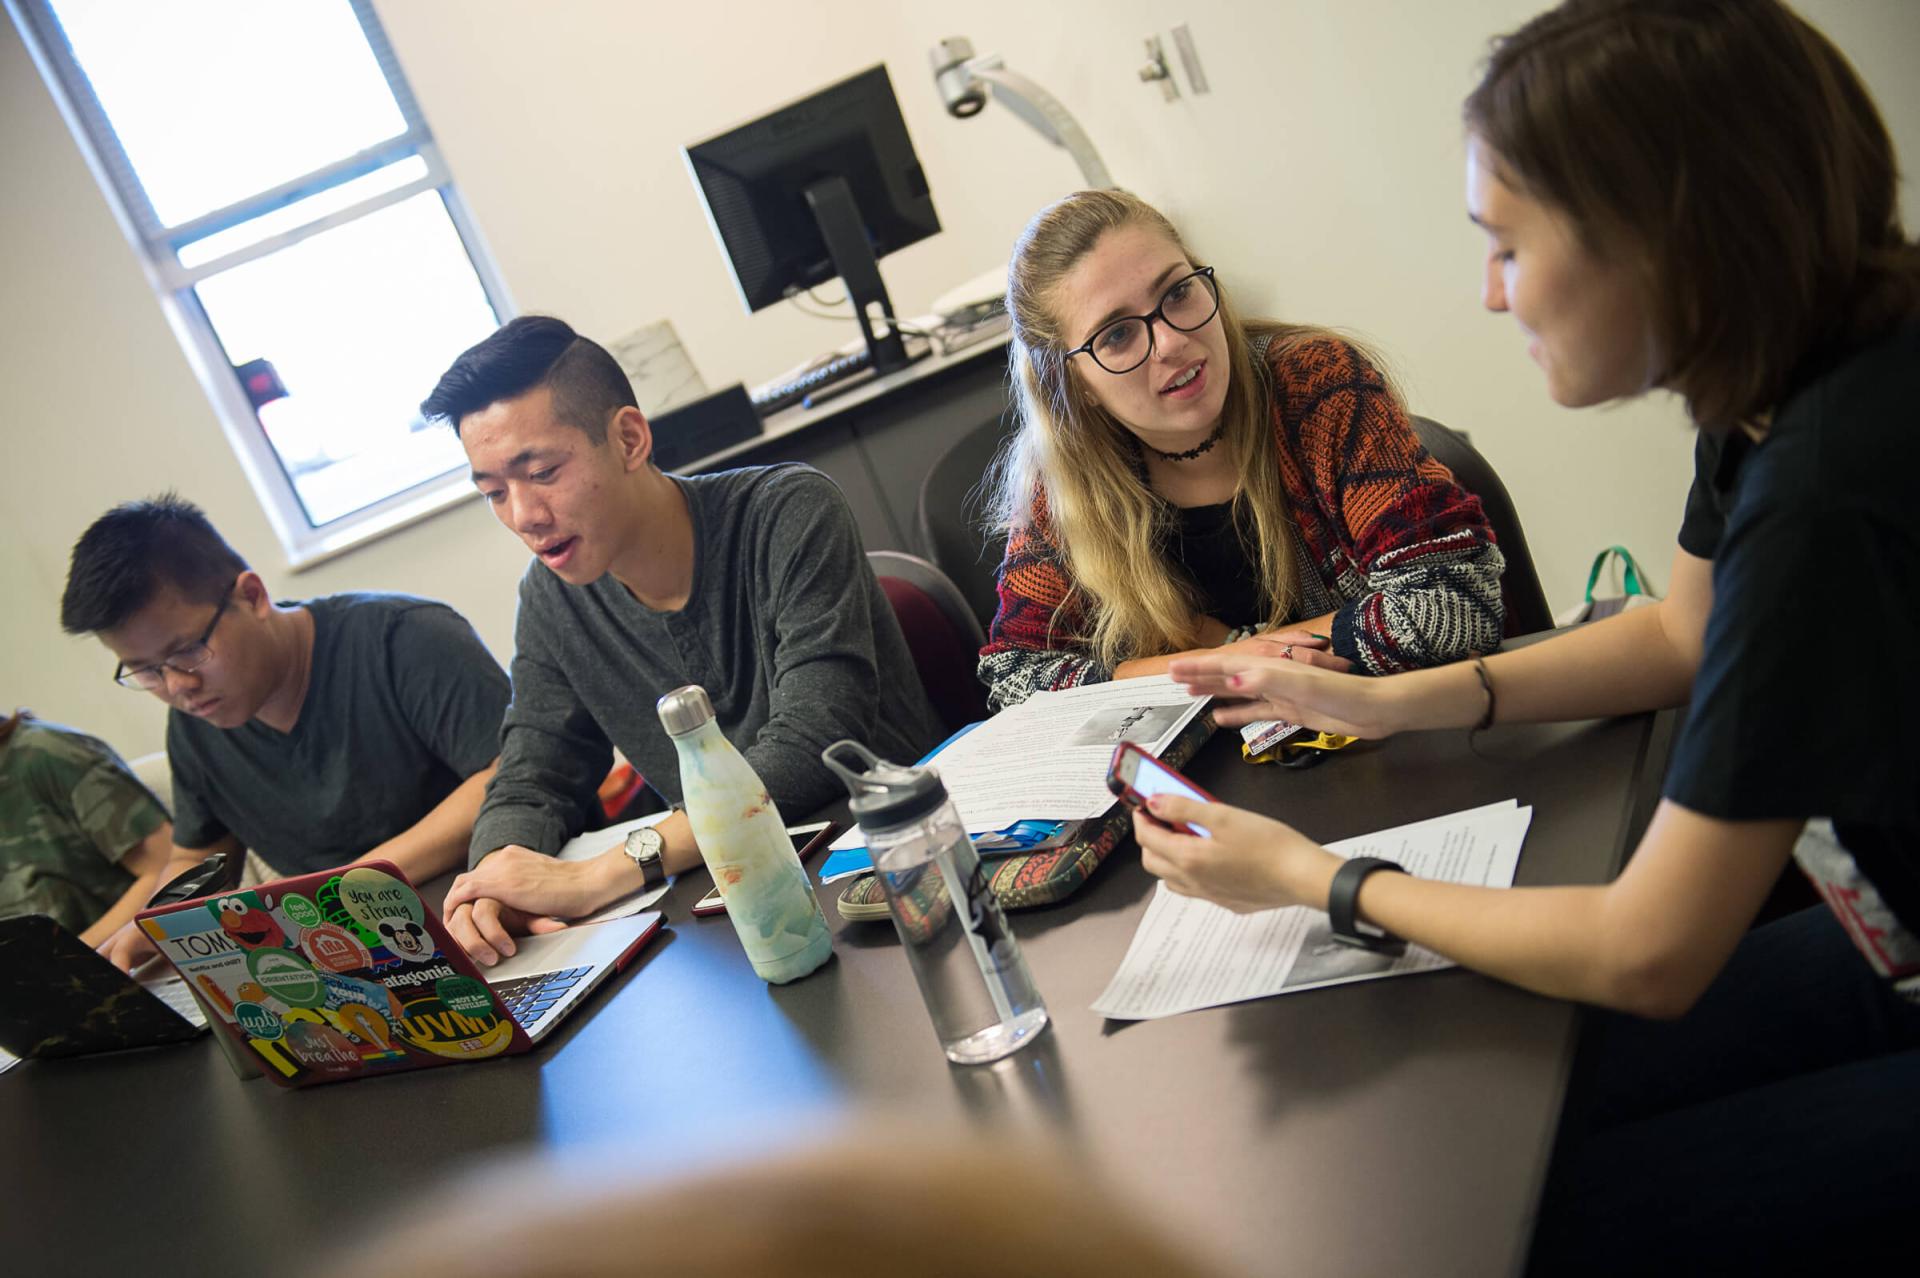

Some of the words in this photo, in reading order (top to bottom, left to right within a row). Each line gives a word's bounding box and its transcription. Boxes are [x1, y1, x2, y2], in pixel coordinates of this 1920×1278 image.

[348, 890, 373, 904] you
[378, 888, 402, 900] are
[289, 902, 307, 911] feel
[292, 909, 315, 920] good
[360, 904, 413, 921] strong
[383, 964, 456, 988] atagonia
[401, 1010, 490, 1041] UVM
[295, 1047, 359, 1062] breathe
